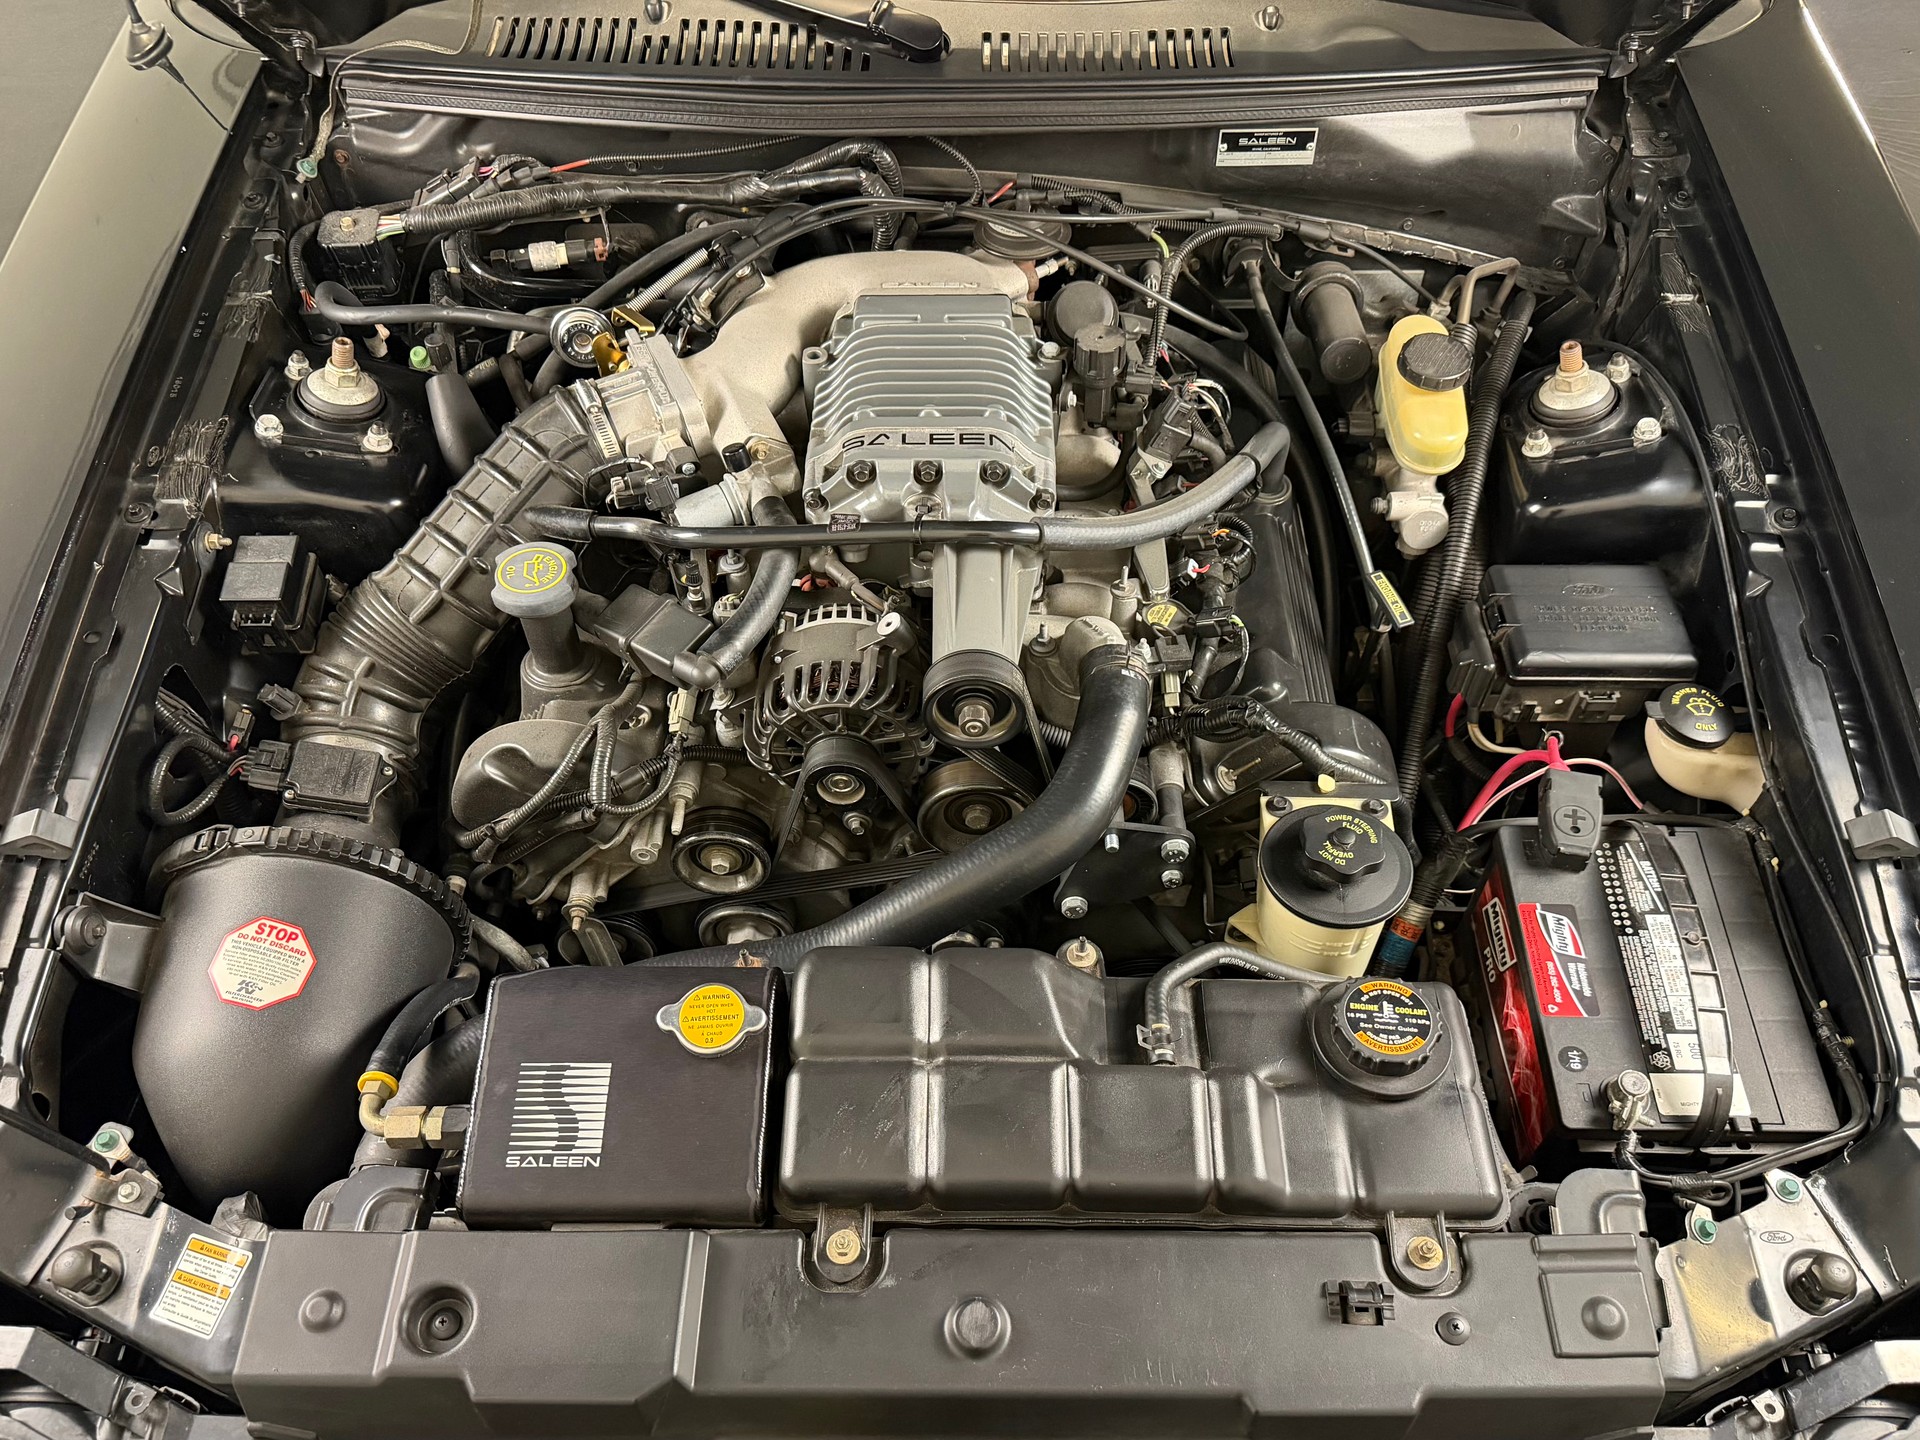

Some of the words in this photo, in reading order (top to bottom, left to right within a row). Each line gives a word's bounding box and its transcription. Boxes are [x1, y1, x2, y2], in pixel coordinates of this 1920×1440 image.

[1238, 136, 1297, 146] SALEEN
[842, 432, 1016, 454] SALEEN
[506, 565, 515, 579] OIL
[540, 556, 558, 583] ENGINE
[1672, 687, 1697, 705] WASHER
[1701, 690, 1725, 708] FLUID
[1695, 722, 1718, 731] ONLY
[1325, 815, 1353, 823] POWER
[1354, 818, 1378, 844] STEERING
[1343, 822, 1364, 835] FLUID
[1319, 850, 1333, 861] NOT
[1323, 840, 1354, 859] OVERFILL
[1335, 858, 1346, 866] DO
[255, 922, 299, 943] STOP
[1490, 902, 1508, 967] Mighty
[1549, 914, 1570, 954] Mighty
[238, 932, 249, 940] DO
[250, 935, 268, 944] NOT
[269, 941, 306, 957] DISCARD
[262, 946, 288, 957] EQUIPPED
[288, 953, 301, 961] WITH
[282, 957, 299, 967] FILTER
[1484, 948, 1496, 983] PRO
[1565, 963, 1582, 989] Warranty
[1371, 983, 1408, 995] WARNING
[1361, 994, 1370, 1002] DO
[1383, 990, 1400, 998] OPEN
[1401, 995, 1414, 1006] HOT
[1350, 1002, 1379, 1011] ENGINE
[1395, 1006, 1428, 1016] COOLANT
[690, 1014, 740, 1022] AVERTISSEMENT
[1374, 1023, 1396, 1031] Owner
[1364, 1039, 1421, 1053] AVERTISSEMENT
[1394, 1035, 1413, 1044] CHAUD
[1687, 1043, 1702, 1058] 500
[505, 1156, 600, 1168] SALEEN
